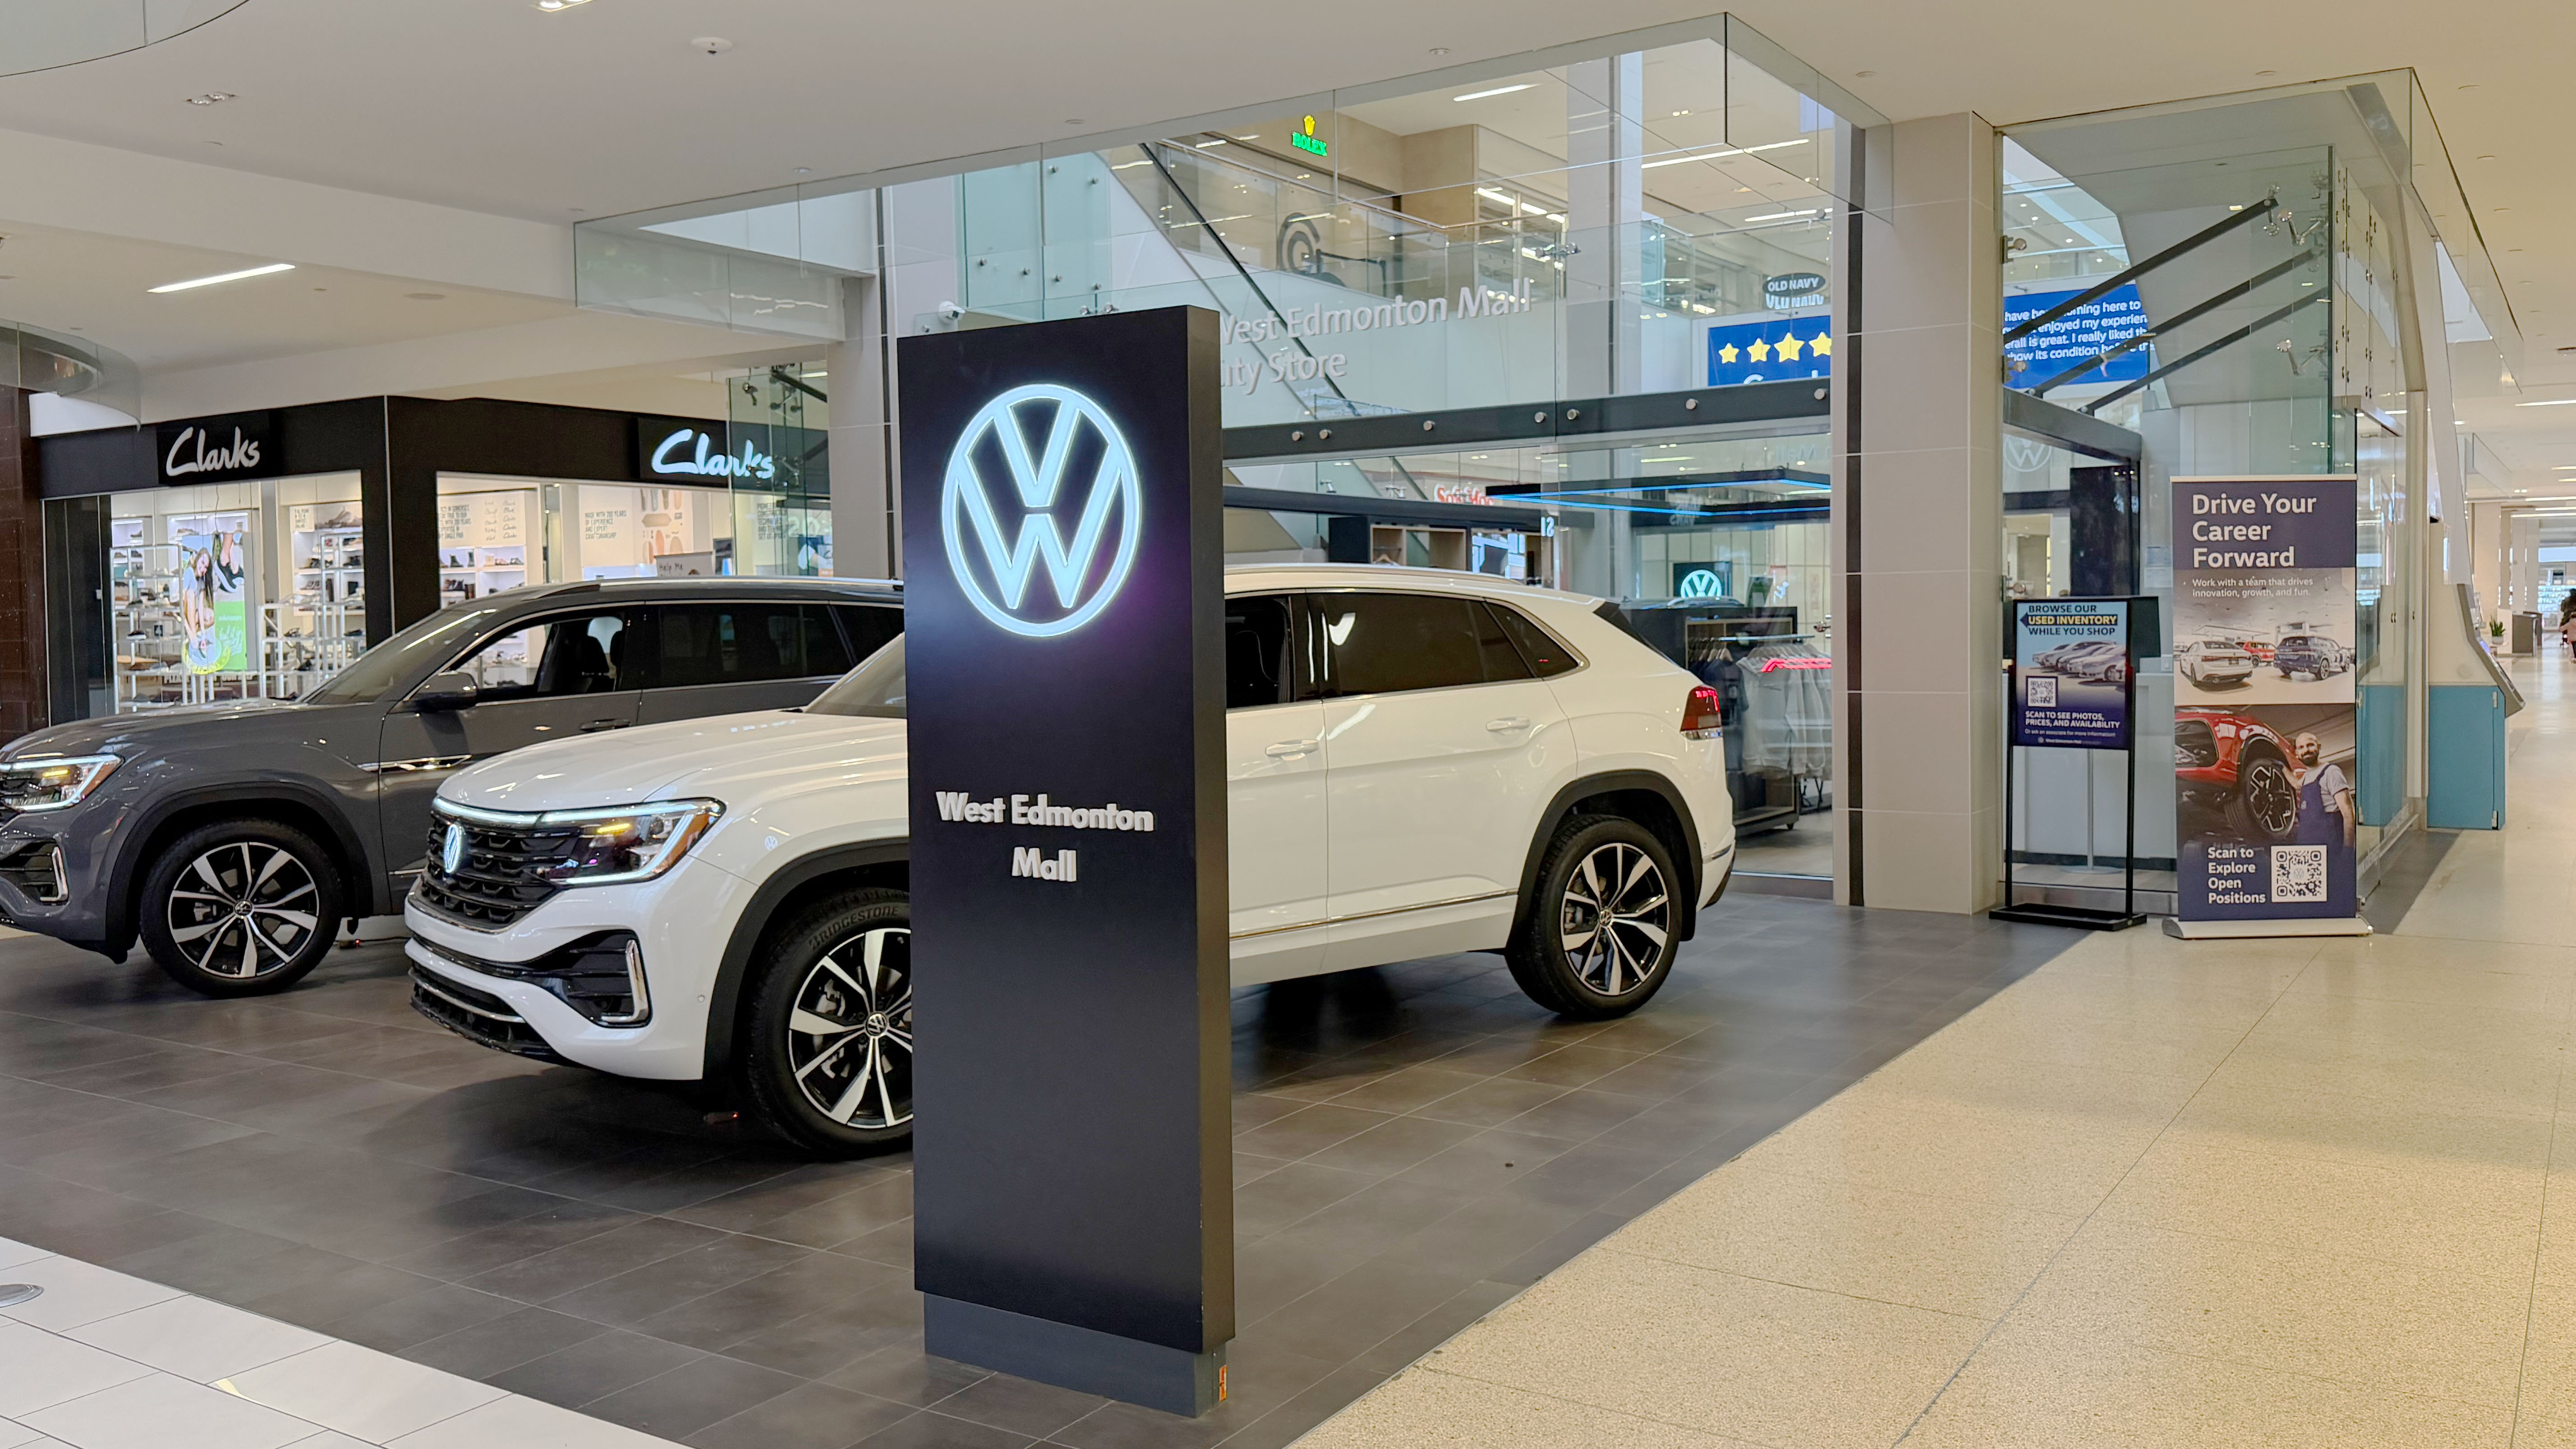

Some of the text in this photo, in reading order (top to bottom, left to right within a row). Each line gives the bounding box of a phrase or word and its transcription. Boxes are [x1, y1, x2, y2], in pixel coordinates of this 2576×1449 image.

[1293, 132, 1327, 156] ROLEX
[1767, 277, 1820, 292] OLD NAVY
[1287, 294, 1447, 339] Edmonton
[1458, 277, 1531, 319] Mall
[2005, 311, 2030, 322] have
[2102, 302, 2128, 313] here
[2129, 300, 2142, 310] to
[2038, 318, 2080, 334] enjoyed
[2082, 318, 2100, 330] my
[2029, 337, 2038, 347] is
[2039, 335, 2070, 349] great.
[2072, 333, 2076, 343] I
[2078, 331, 2107, 343] really
[2109, 327, 2134, 340] liked
[2036, 350, 2048, 359] its
[2050, 346, 2099, 360] condition
[1220, 353, 1347, 395] ity Store
[166, 426, 260, 476] Clarks
[651, 428, 775, 479] Clarks
[2193, 493, 2317, 515] Drive Your
[2192, 520, 2271, 541] Career
[2193, 546, 2295, 568] Forward
[2193, 578, 2216, 586] Work
[2217, 578, 2236, 586] with
[2268, 578, 2285, 586] that
[2287, 577, 2313, 585] drives
[2192, 588, 2310, 598] innovation, growth, and fun.
[2029, 605, 2072, 613] BROWSE
[2029, 615, 2117, 625] USED INVENTORY
[2029, 627, 2061, 635] WHILE
[2085, 627, 2115, 635] SHOP
[2025, 718, 2052, 727] PRICES,
[2070, 720, 2120, 729] AVAILABILITY
[2072, 713, 2105, 721] PHOTOS,
[936, 791, 1154, 832] West Edmonton
[2208, 847, 2254, 858] Scan to
[1012, 847, 1077, 882] Mall
[2208, 861, 2256, 876] Explore
[2208, 877, 2242, 891] Open
[2208, 891, 2266, 904] Positions
[809, 905, 899, 951] BRIDGESTONE
